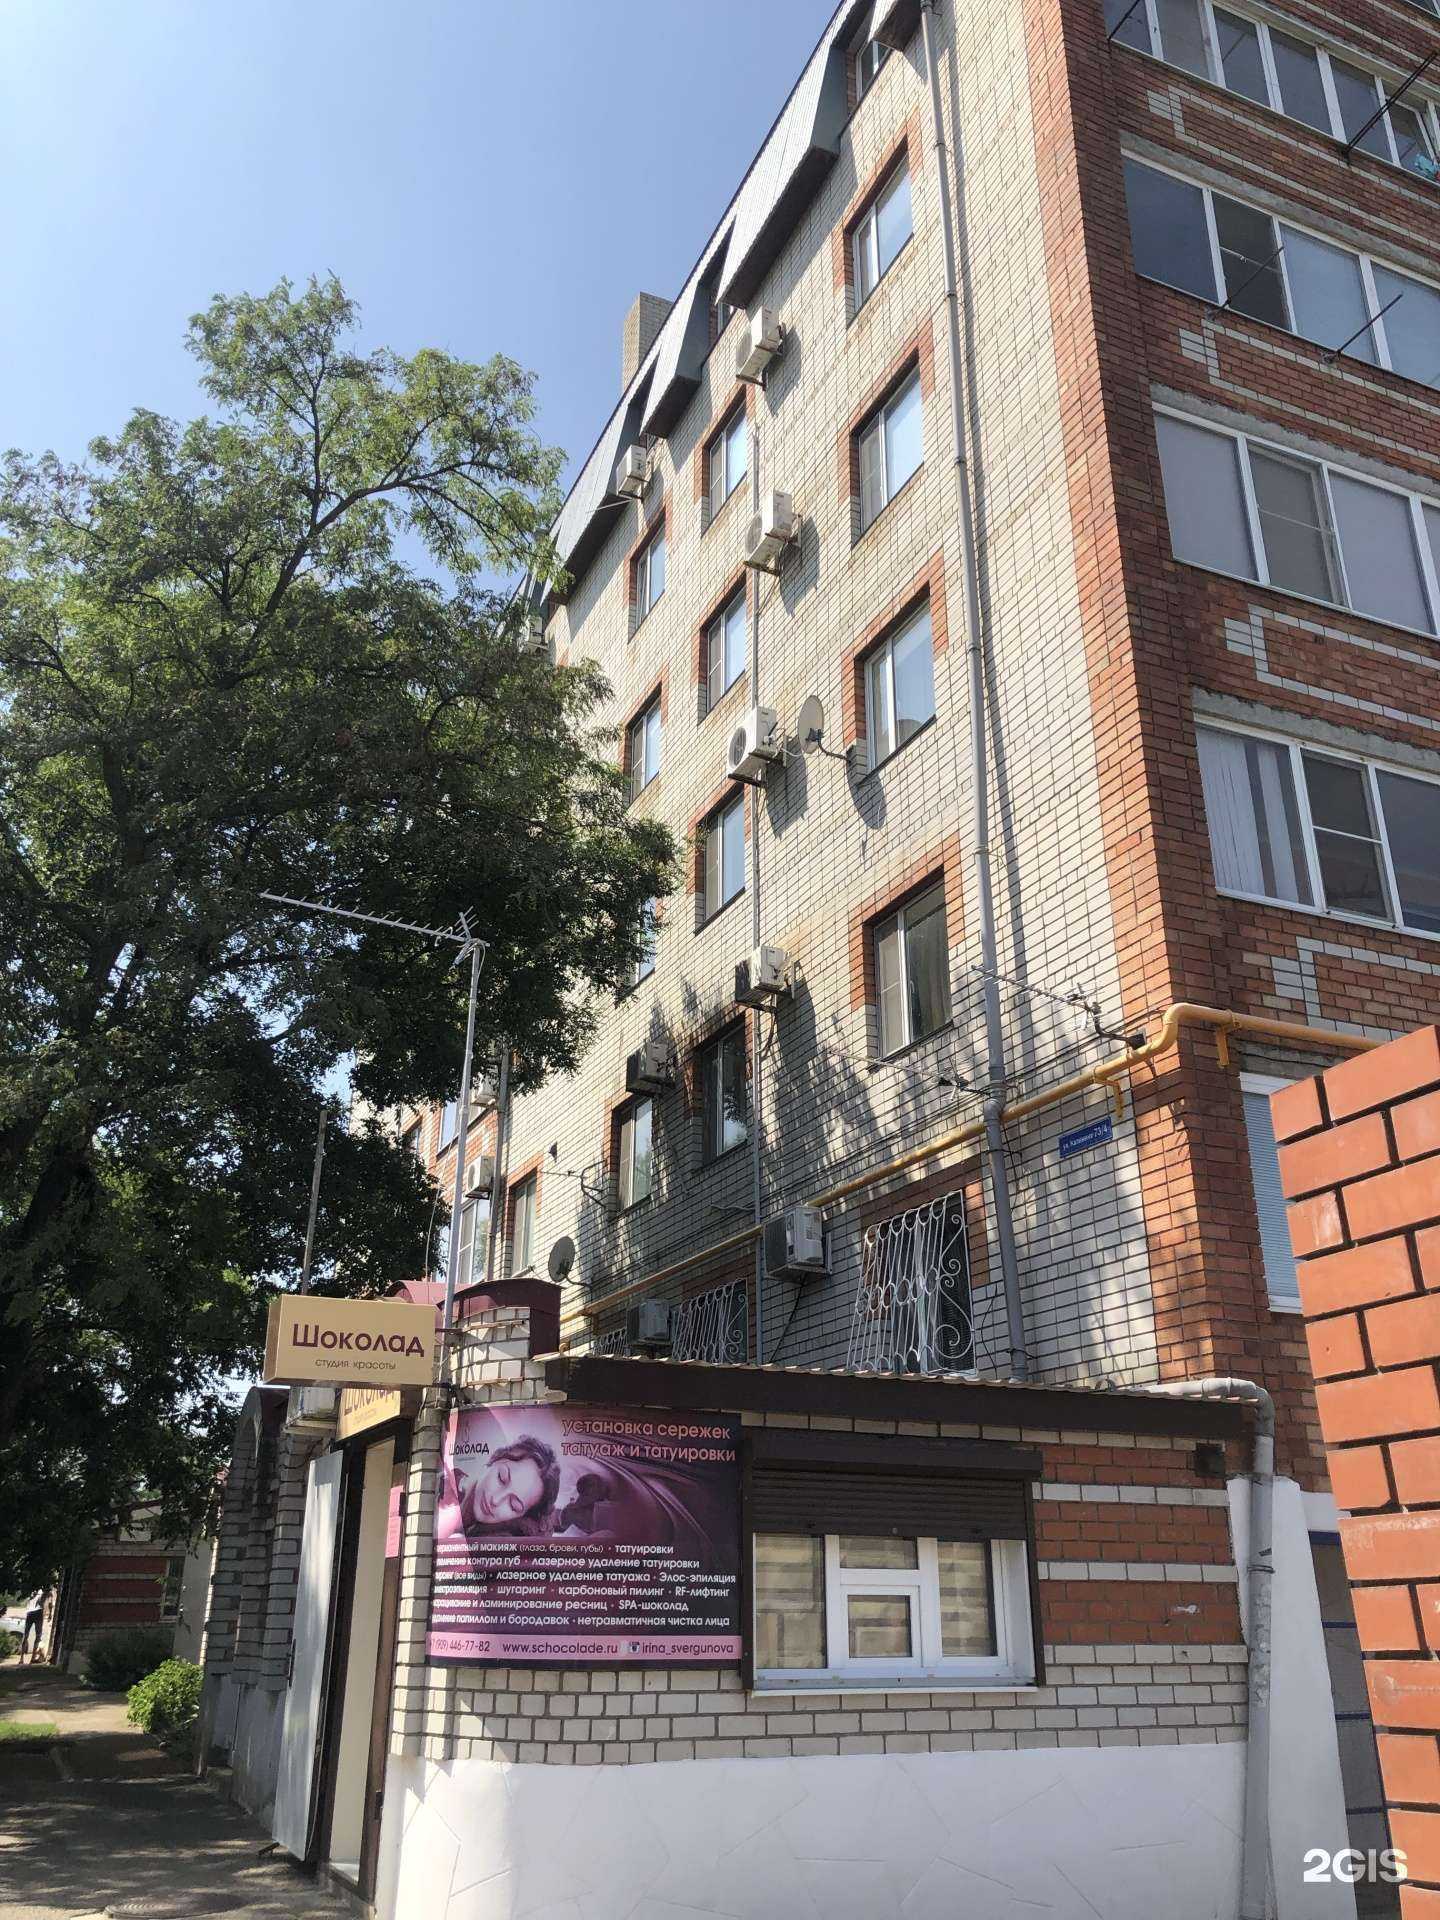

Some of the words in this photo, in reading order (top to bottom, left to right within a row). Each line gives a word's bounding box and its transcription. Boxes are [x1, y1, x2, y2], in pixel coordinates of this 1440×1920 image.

[292, 1323, 425, 1358] Шоколад
[315, 1358, 349, 1369] студия
[353, 1360, 397, 1371] красоты
[344, 1388, 395, 1416] Шоко
[562, 1419, 653, 1437] установка
[657, 1423, 732, 1440] сережек
[562, 1442, 626, 1459] татуаж
[630, 1445, 640, 1457] и
[643, 1445, 736, 1463] татуировки
[480, 1543, 517, 1552] макияж
[615, 1545, 674, 1556] татуировки
[467, 1557, 502, 1567] контура
[504, 1556, 521, 1567] губ
[532, 1557, 585, 1568] лазерное
[588, 1558, 640, 1568] удаление
[642, 1559, 700, 1570] татуировки
[496, 1571, 546, 1582] лазерное
[549, 1571, 603, 1582] удаление
[606, 1573, 650, 1583] татуажа
[659, 1572, 736, 1584] Элос-эпиляция
[497, 1585, 546, 1595] шугаринг
[558, 1585, 627, 1597] карбоновый
[629, 1586, 665, 1595] пилинг
[675, 1586, 730, 1598] RF-лифтинг
[479, 1600, 563, 1610] ламинирование
[565, 1601, 608, 1611] ресниц
[618, 1600, 689, 1612] SPA-шоколад
[456, 1615, 498, 1624] папиллом
[500, 1616, 507, 1624] и
[507, 1614, 570, 1627] бородавок
[577, 1616, 666, 1627] нетравматичная
[667, 1617, 703, 1626] чистка
[704, 1617, 731, 1627] лица
[502, 1641, 618, 1654] www.schocolade.ru
[642, 1642, 734, 1657] irina_svergunova
